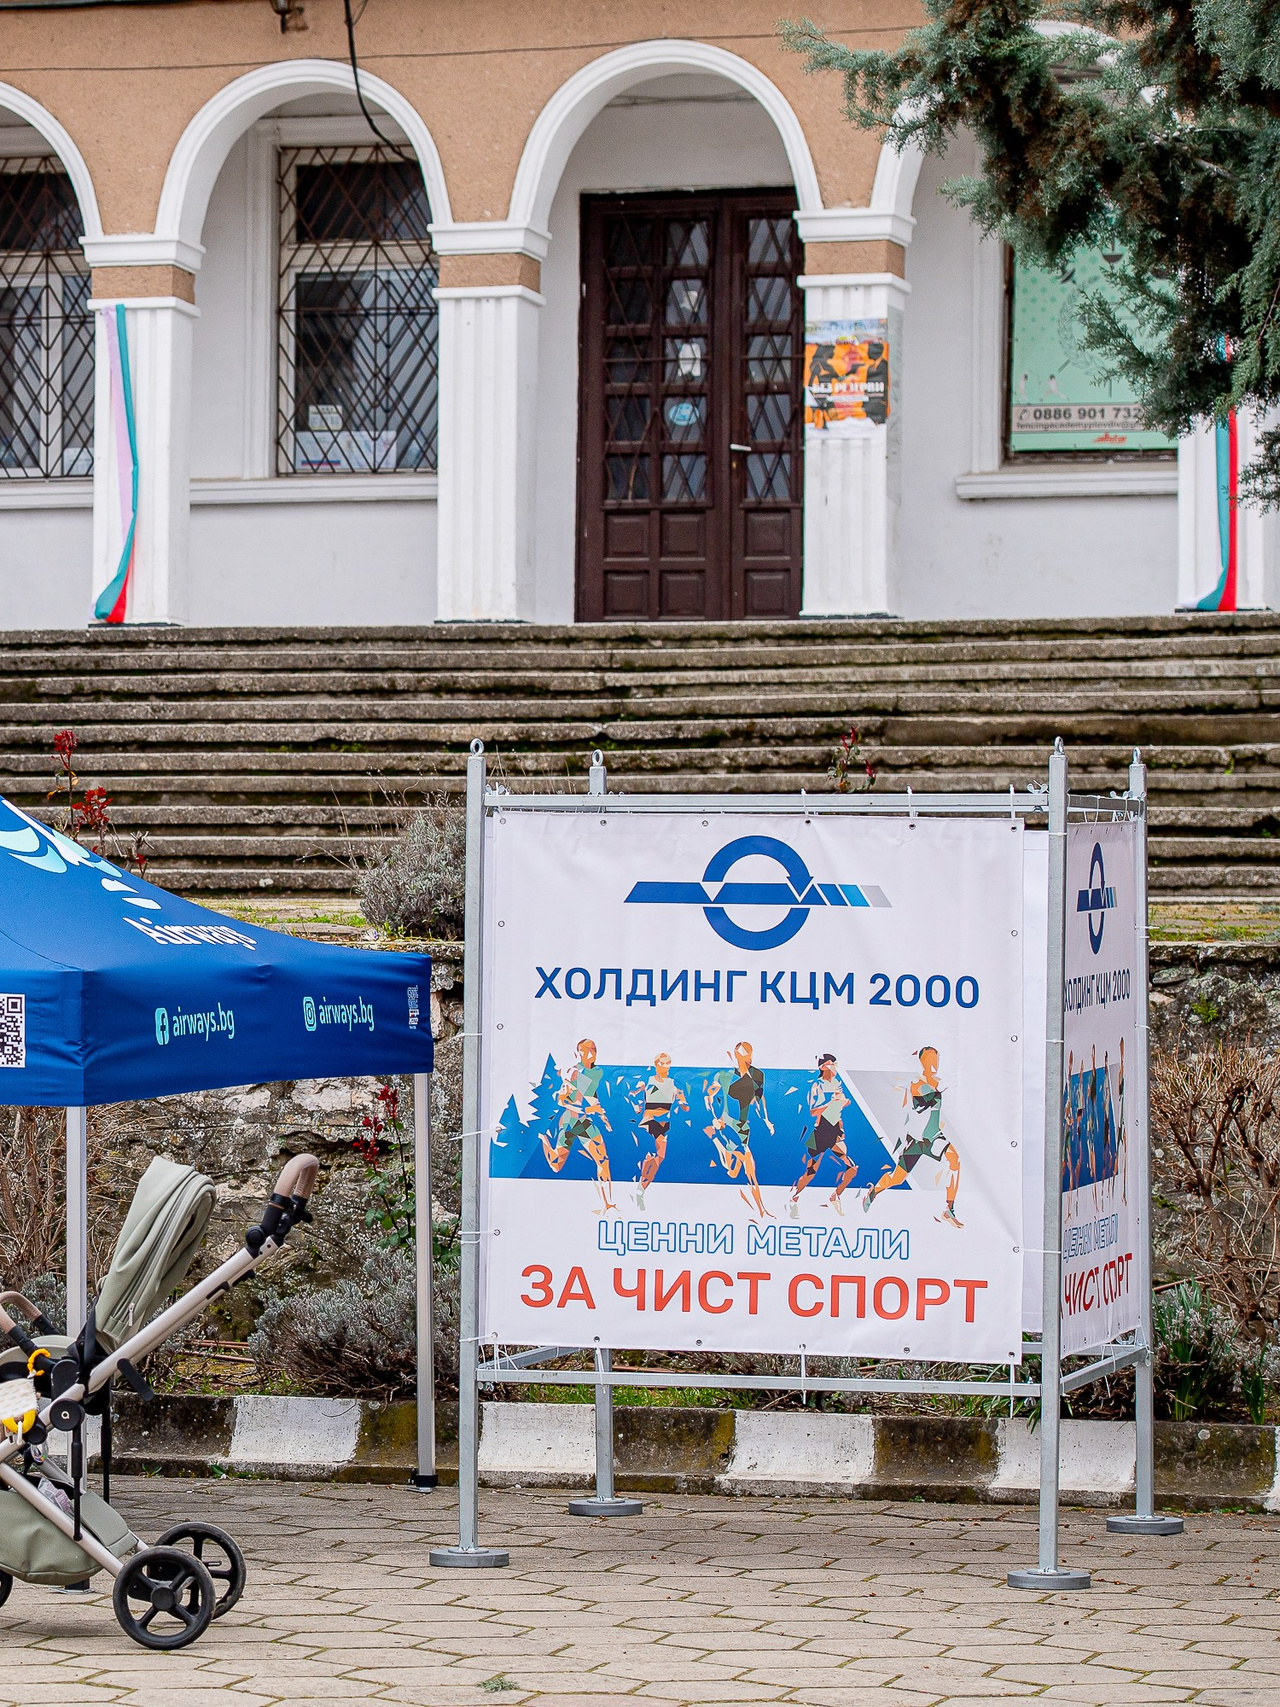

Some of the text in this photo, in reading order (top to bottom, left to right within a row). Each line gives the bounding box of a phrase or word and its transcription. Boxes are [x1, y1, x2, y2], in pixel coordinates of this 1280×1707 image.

[1033, 407, 1072, 420] 0886
[1078, 407, 1106, 420] 901
[122, 916, 257, 951] Airways
[534, 966, 980, 1010] ХОЛДИНГ КЦМ 2000
[1095, 971, 1111, 1009] КЦМ
[1112, 968, 1130, 1002] 2000
[172, 1002, 235, 1042] airways.bg
[319, 996, 375, 1032] airways.bg
[597, 1219, 912, 1262] ЦЕННИ МЕТАЛИ
[521, 1264, 988, 1323] ЗА ЧИСТ СПОРТ
[1064, 1266, 1099, 1316] ЧИСТ
